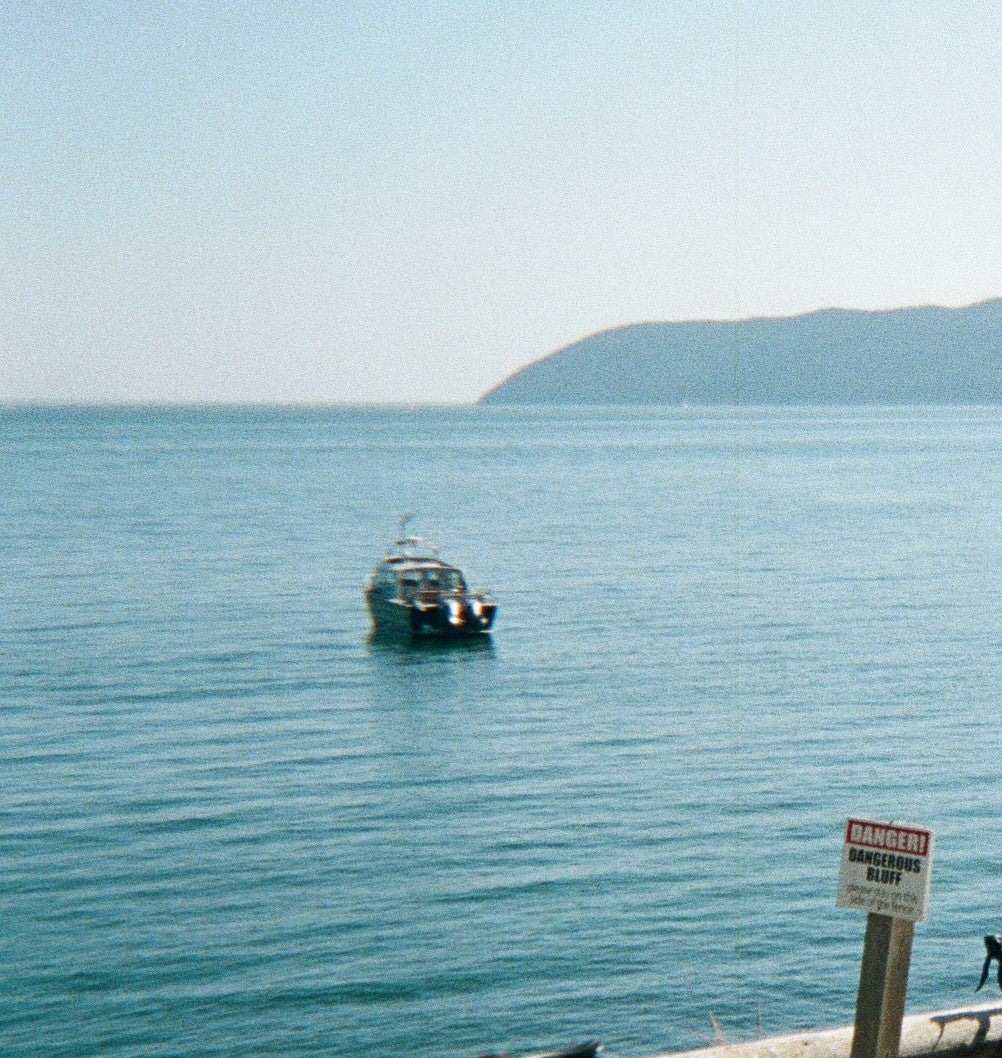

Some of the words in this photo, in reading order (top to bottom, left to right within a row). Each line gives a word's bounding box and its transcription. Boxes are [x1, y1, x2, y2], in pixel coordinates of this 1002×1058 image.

[849, 823, 926, 854] DANGER!
[849, 847, 921, 873] DANGEROUS
[866, 866, 902, 886] BLUFF
